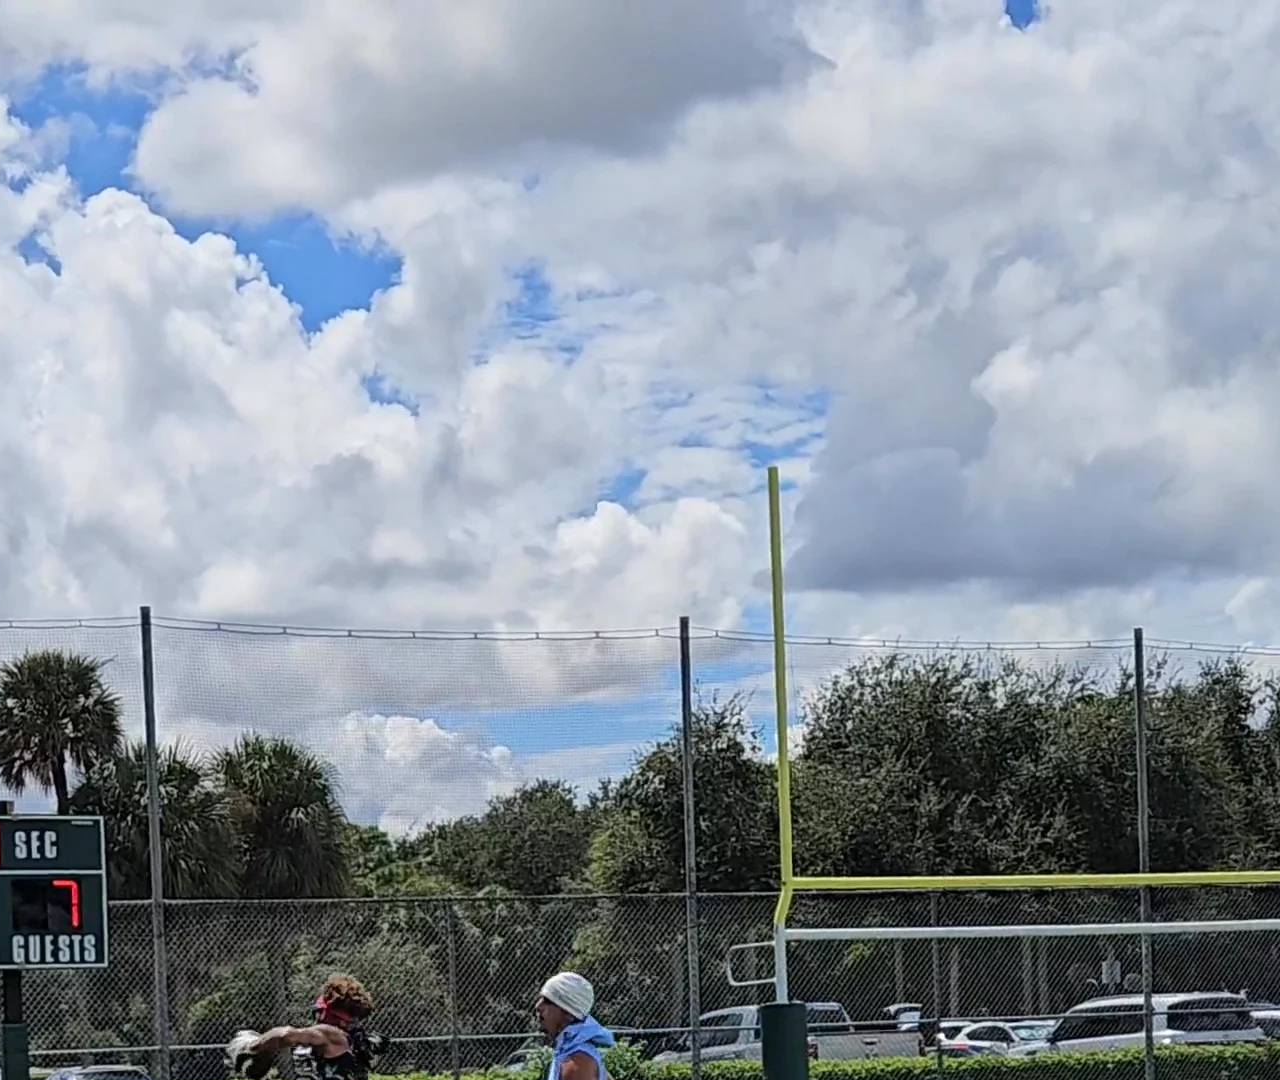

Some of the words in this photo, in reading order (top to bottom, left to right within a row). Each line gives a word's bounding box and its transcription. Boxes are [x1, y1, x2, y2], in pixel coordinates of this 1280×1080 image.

[14, 830, 57, 859] SEC
[52, 880, 80, 930] 7
[12, 935, 96, 963] GUESTS
